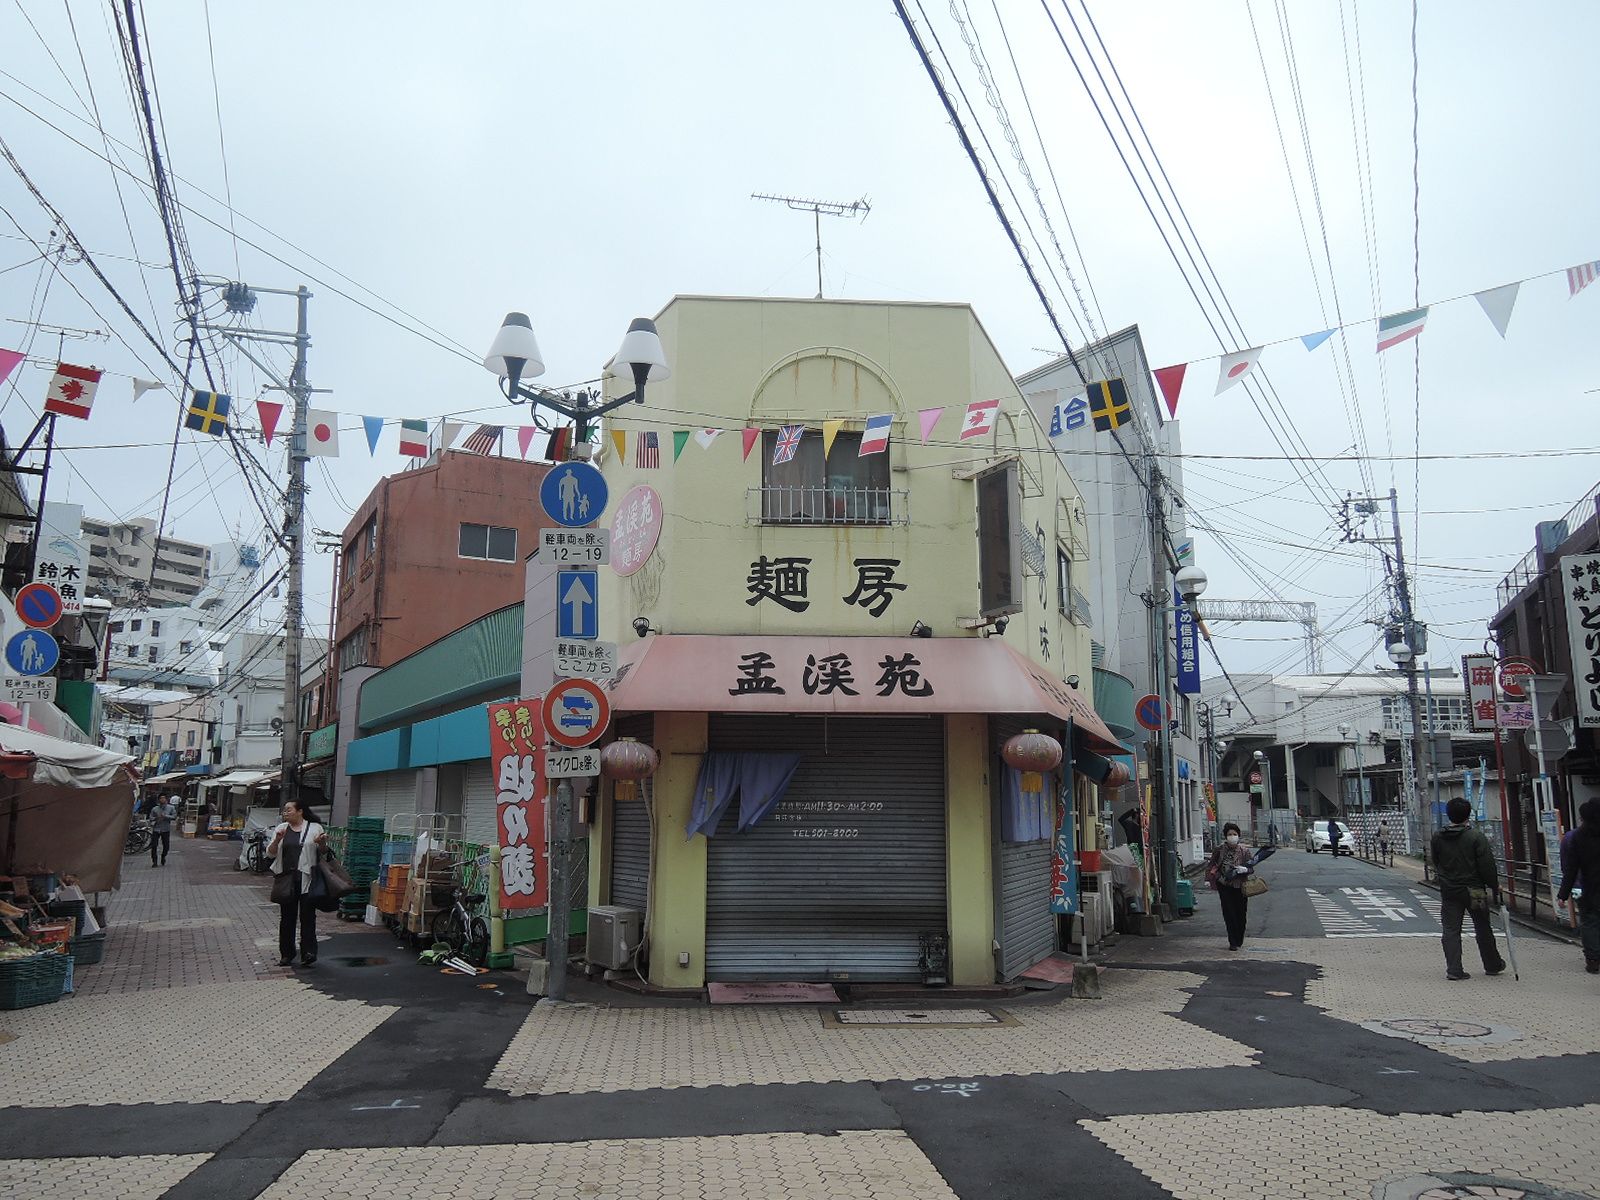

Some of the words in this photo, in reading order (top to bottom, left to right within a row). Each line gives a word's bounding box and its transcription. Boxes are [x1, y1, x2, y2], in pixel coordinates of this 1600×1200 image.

[545, 533, 604, 545] 軽車両を除く
[38, 561, 80, 580] 鈴木
[746, 556, 907, 618] 麺房
[1570, 565, 1589, 601] 串焼
[558, 643, 611, 659] 軽車両を除く
[559, 660, 611, 674] ここから
[728, 652, 934, 697] 孟渓苑
[1471, 666, 1495, 720] 麻雀
[548, 755, 598, 773] マイクロを除く
